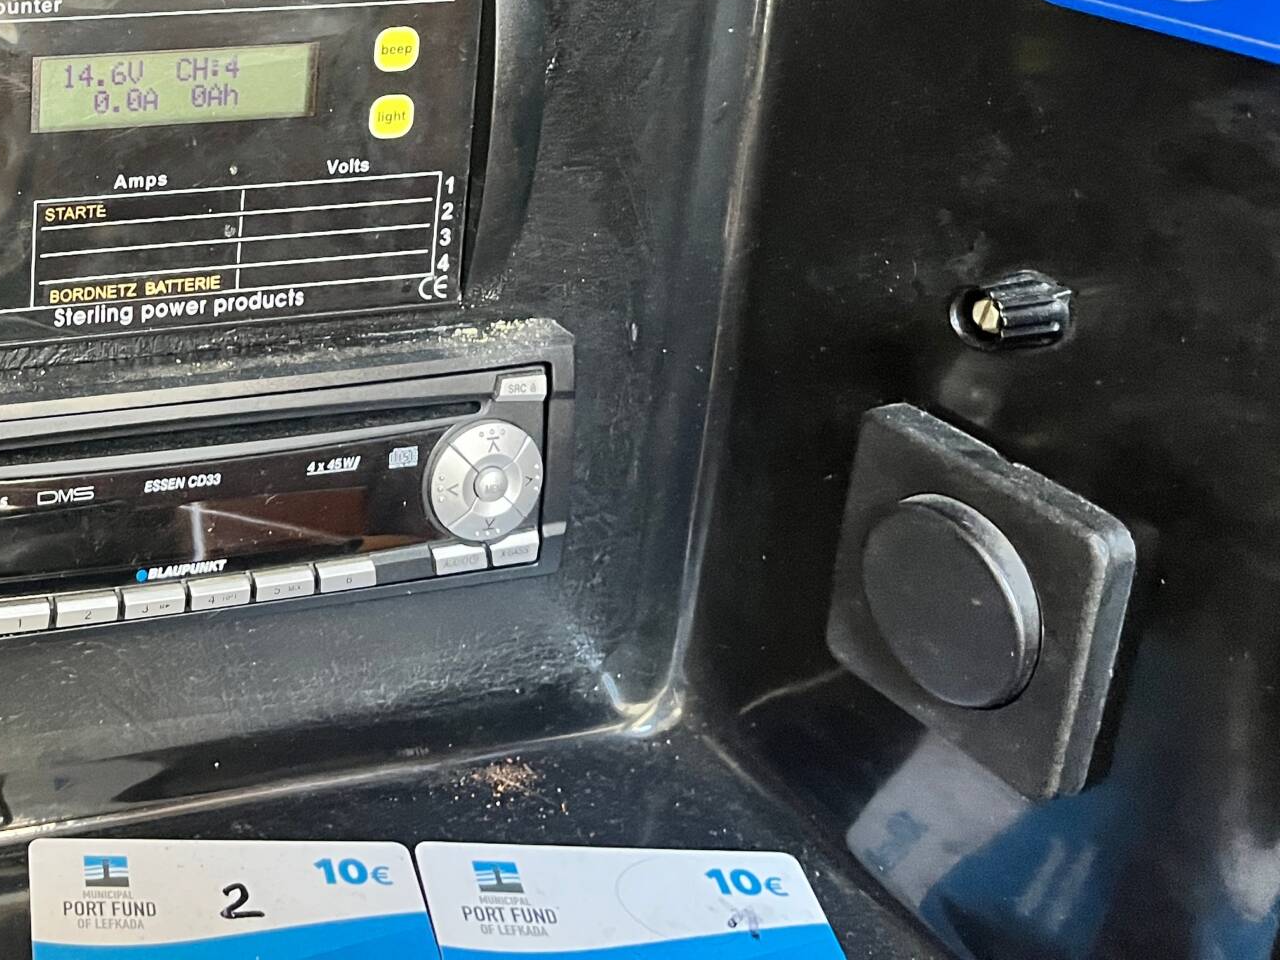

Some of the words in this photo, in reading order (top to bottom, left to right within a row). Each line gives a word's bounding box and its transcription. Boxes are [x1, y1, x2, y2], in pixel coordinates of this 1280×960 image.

[65, 60, 145, 89] 14.6V
[94, 88, 158, 114] 0.0A
[192, 83, 239, 107] 0Ah
[377, 109, 406, 125] light
[114, 173, 168, 190] Amps
[327, 158, 370, 175] Volts
[45, 203, 107, 222] STARTE
[50, 282, 138, 304] BORDNETZ
[145, 274, 221, 296] BATTERIE
[54, 302, 133, 327] Sterling
[141, 298, 208, 320] power
[214, 289, 304, 314] products
[144, 475, 185, 493] ESSEN
[187, 473, 221, 490] CD33
[37, 486, 94, 505] DMS
[147, 559, 227, 581] BLAUPUNKT
[314, 857, 394, 886] 10€
[704, 868, 789, 897] 10€
[82, 890, 133, 899] MUNICIPAL
[220, 882, 265, 919] 2
[479, 896, 531, 907] MUNICIPAL
[63, 901, 104, 917] PORT
[112, 901, 157, 917] FUND
[461, 905, 507, 924] PORT
[510, 906, 558, 925] FUND
[77, 919, 91, 930] OF
[94, 918, 145, 930] LEFKADA
[480, 924, 496, 936] OF
[498, 924, 549, 937] LEFKADA
